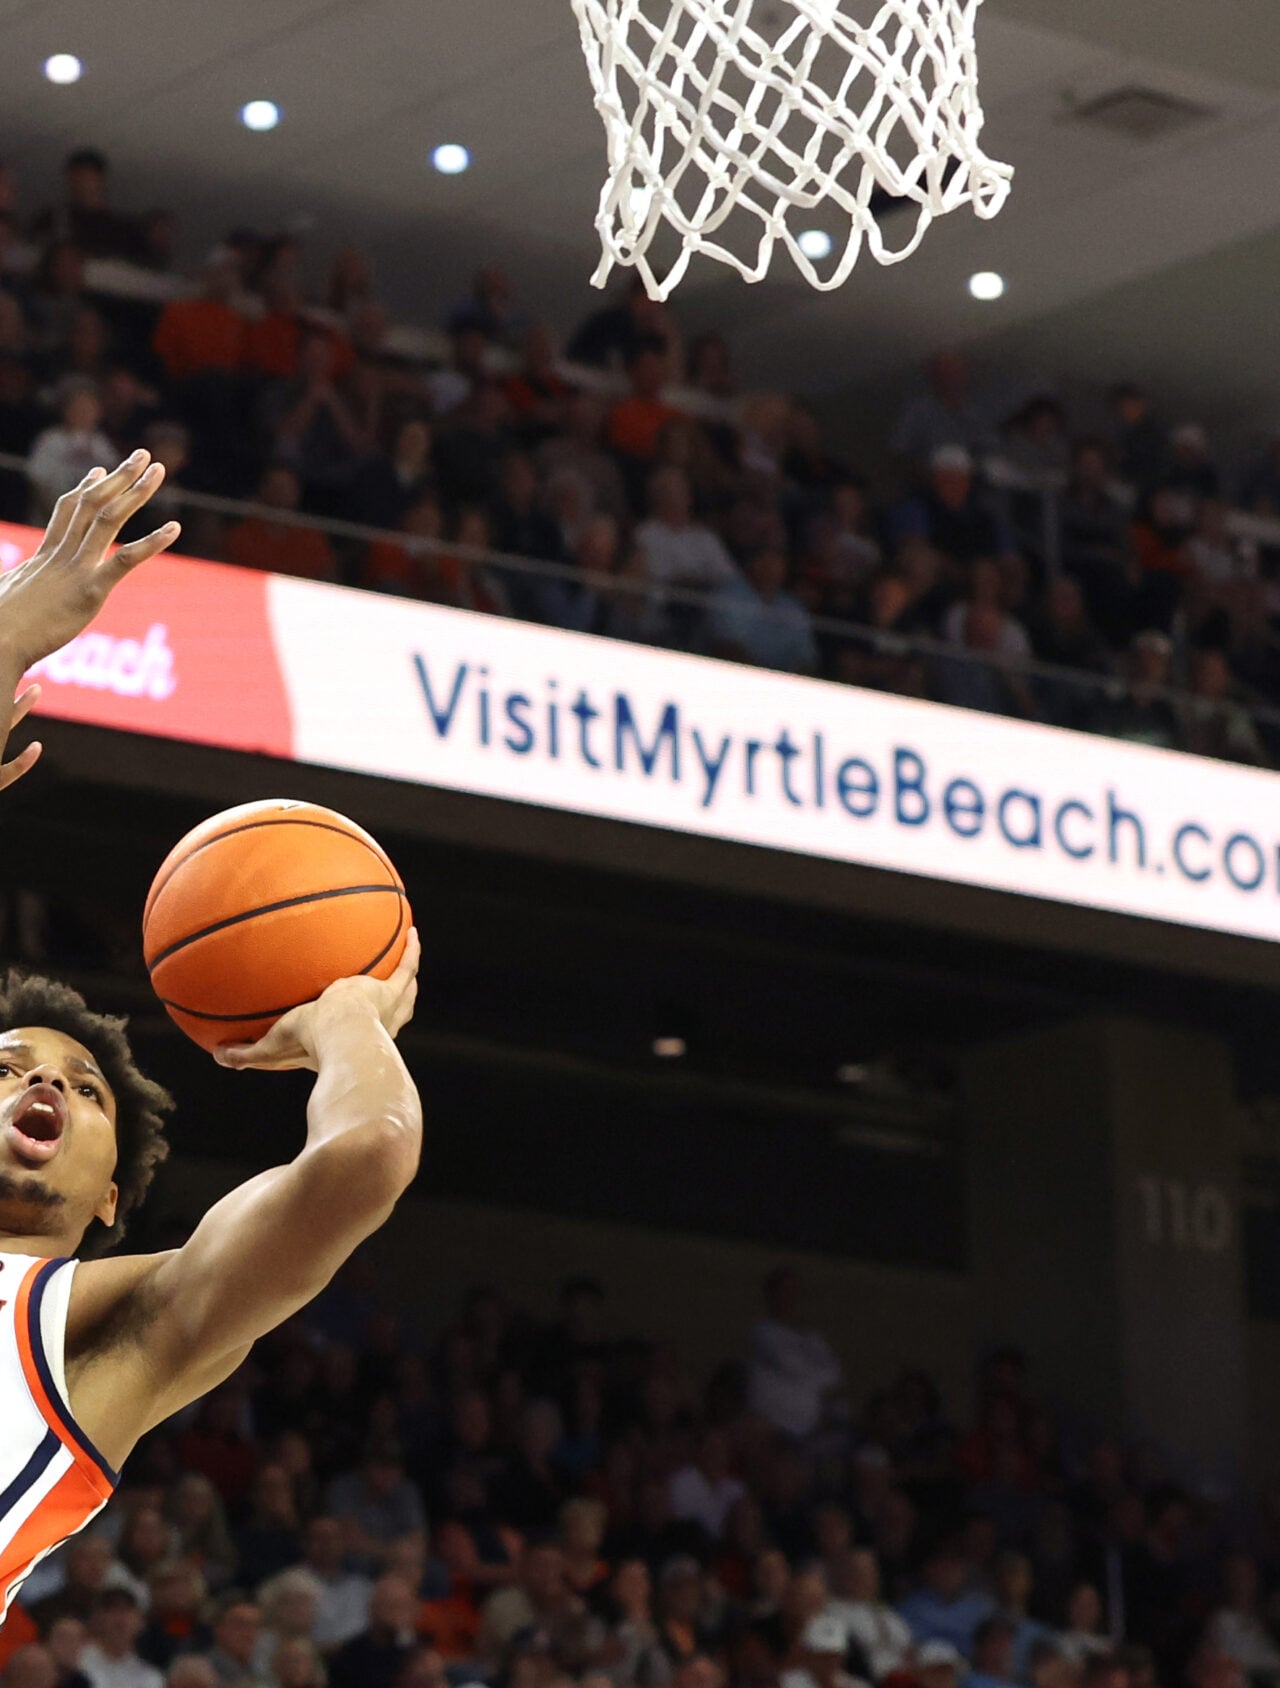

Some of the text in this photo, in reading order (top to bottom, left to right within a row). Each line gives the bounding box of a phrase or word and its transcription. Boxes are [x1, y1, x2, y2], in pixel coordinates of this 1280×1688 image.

[24, 622, 177, 699] each
[412, 652, 1280, 897] VisitMyrtleBeach.co
[1137, 1175, 1235, 1251] 110
